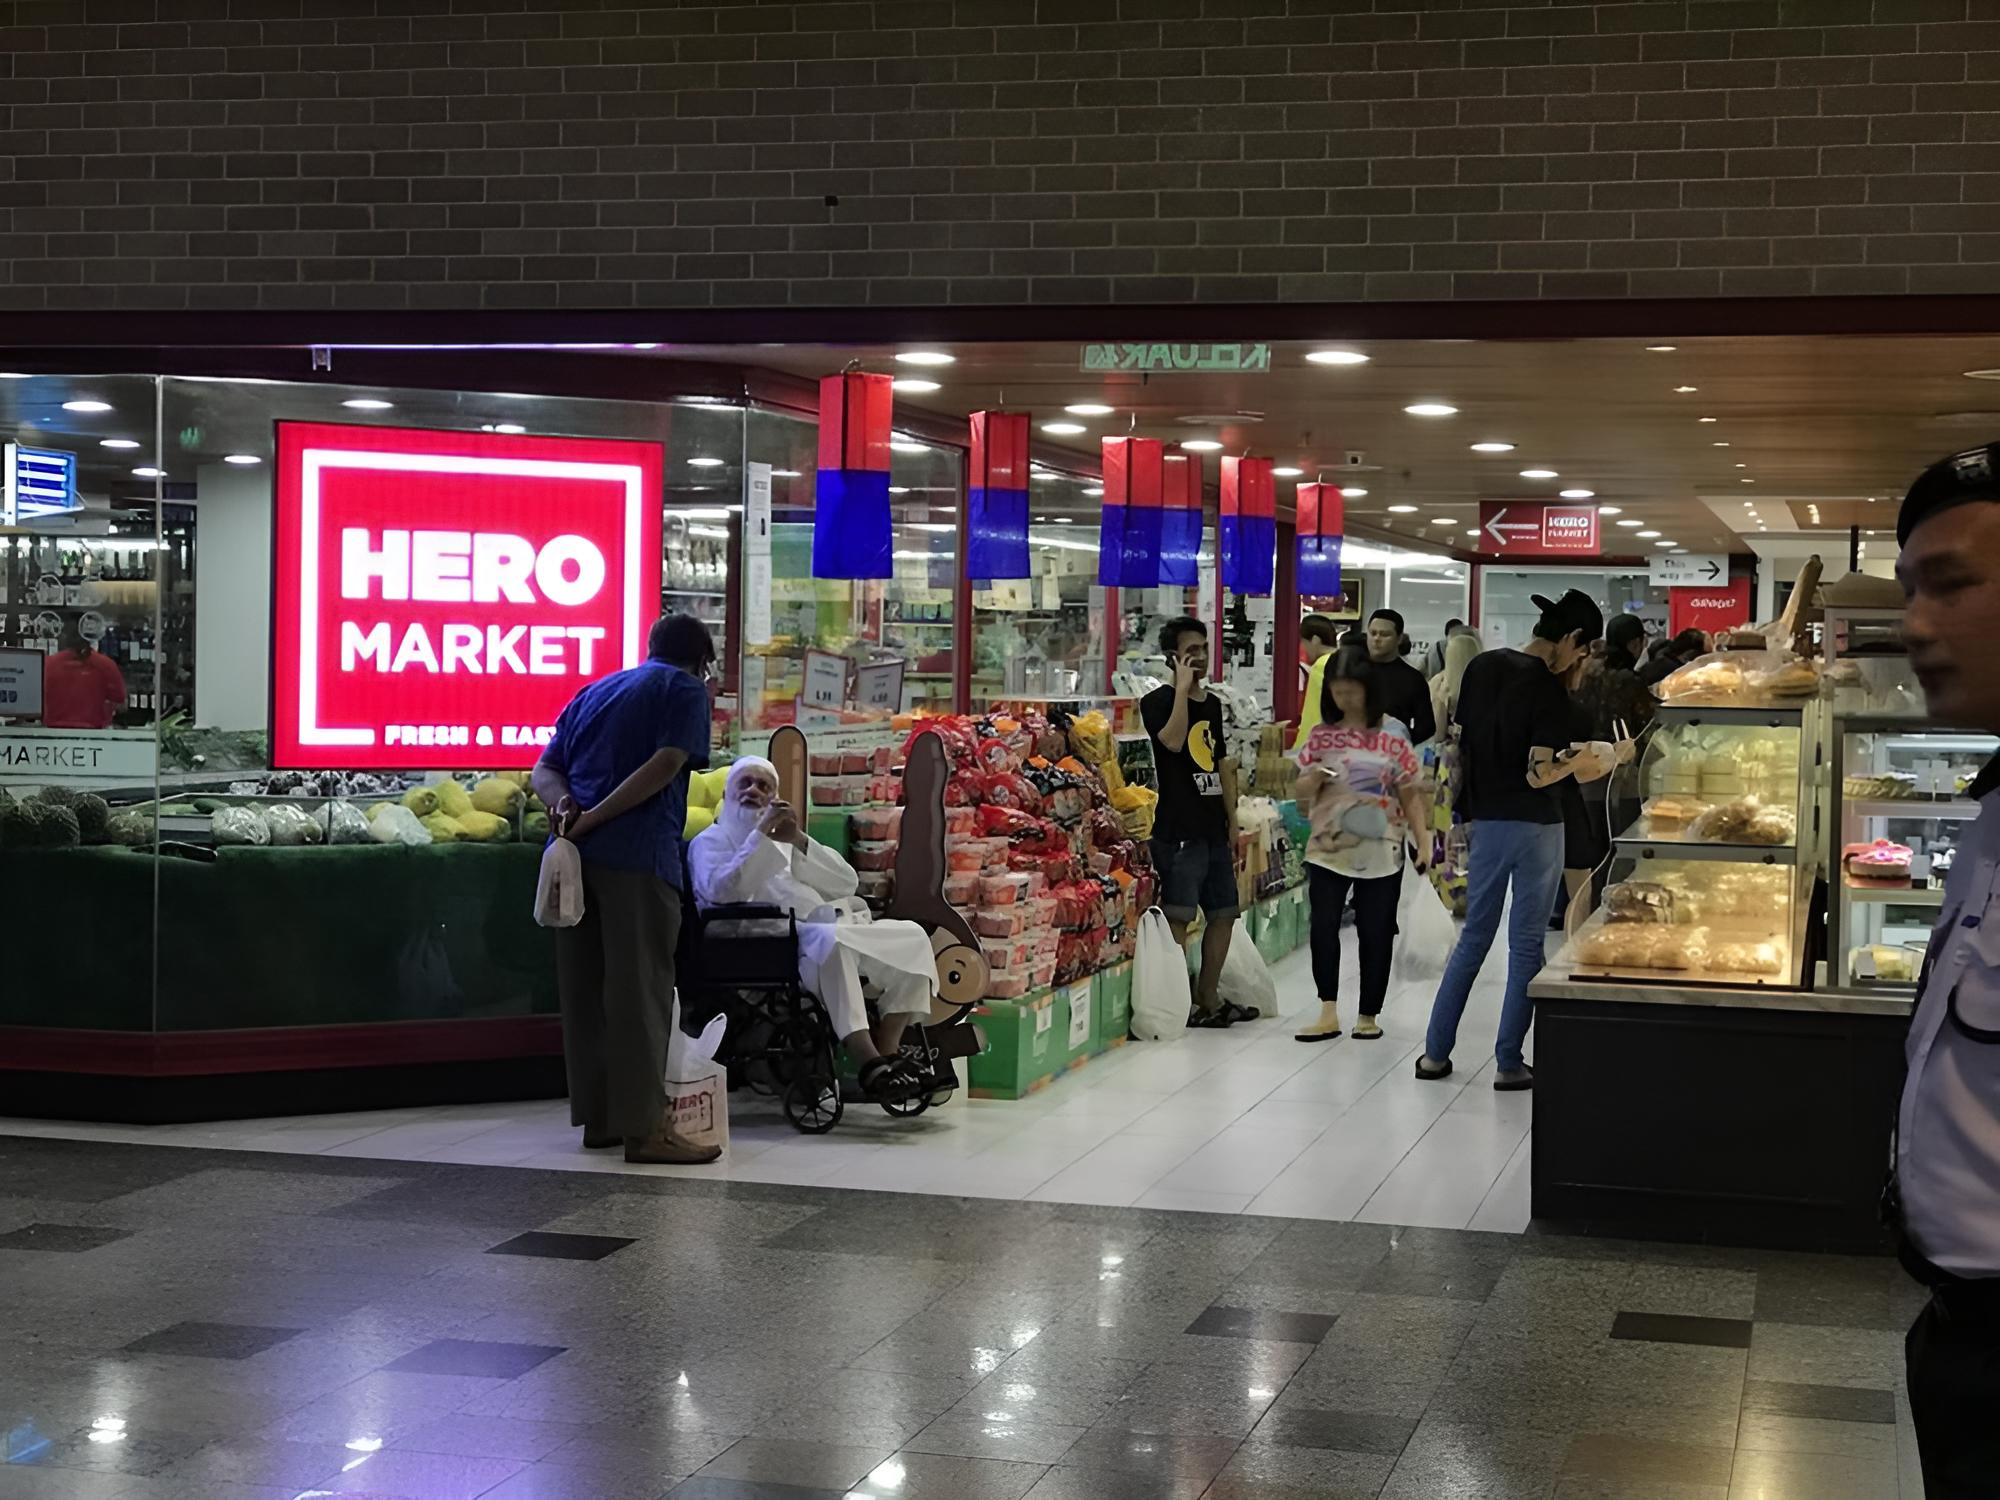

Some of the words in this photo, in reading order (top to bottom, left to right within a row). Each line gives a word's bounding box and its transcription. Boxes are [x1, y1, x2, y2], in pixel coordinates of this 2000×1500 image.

[341, 528, 605, 606] HERO
[341, 621, 605, 676] MARKET
[384, 725, 468, 746] FRESH
[475, 725, 493, 745] &
